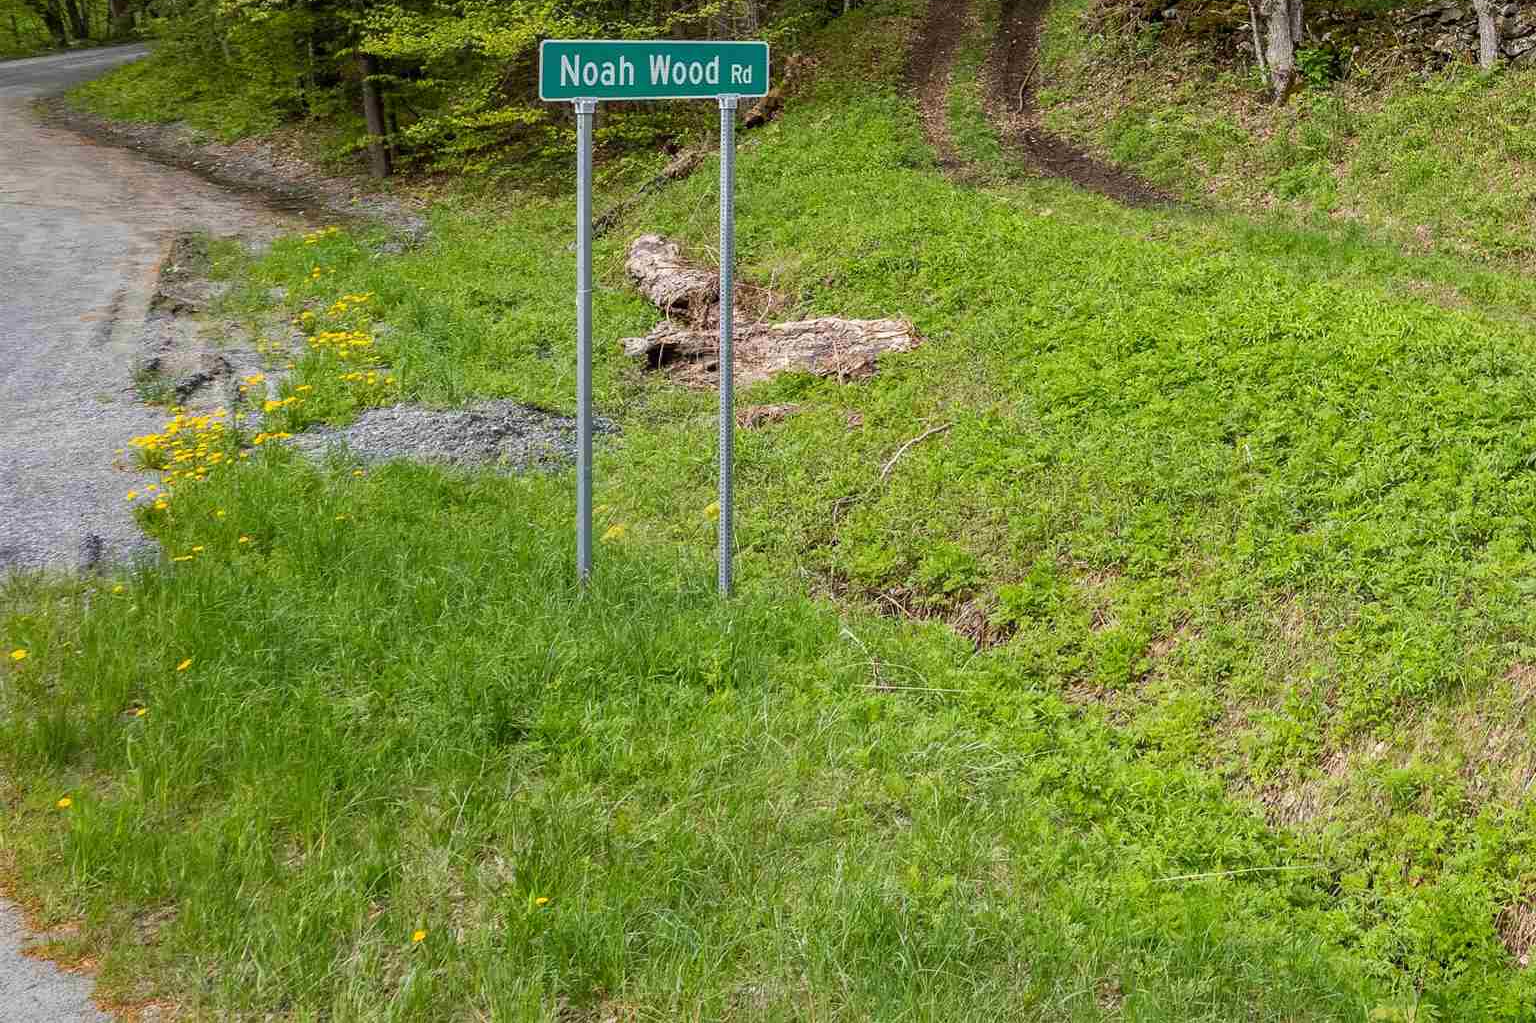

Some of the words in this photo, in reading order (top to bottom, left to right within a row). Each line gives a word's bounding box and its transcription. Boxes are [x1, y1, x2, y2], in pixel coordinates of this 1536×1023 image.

[560, 54, 635, 87] Noah
[649, 54, 720, 85] Wood
[731, 64, 753, 84] Rd
